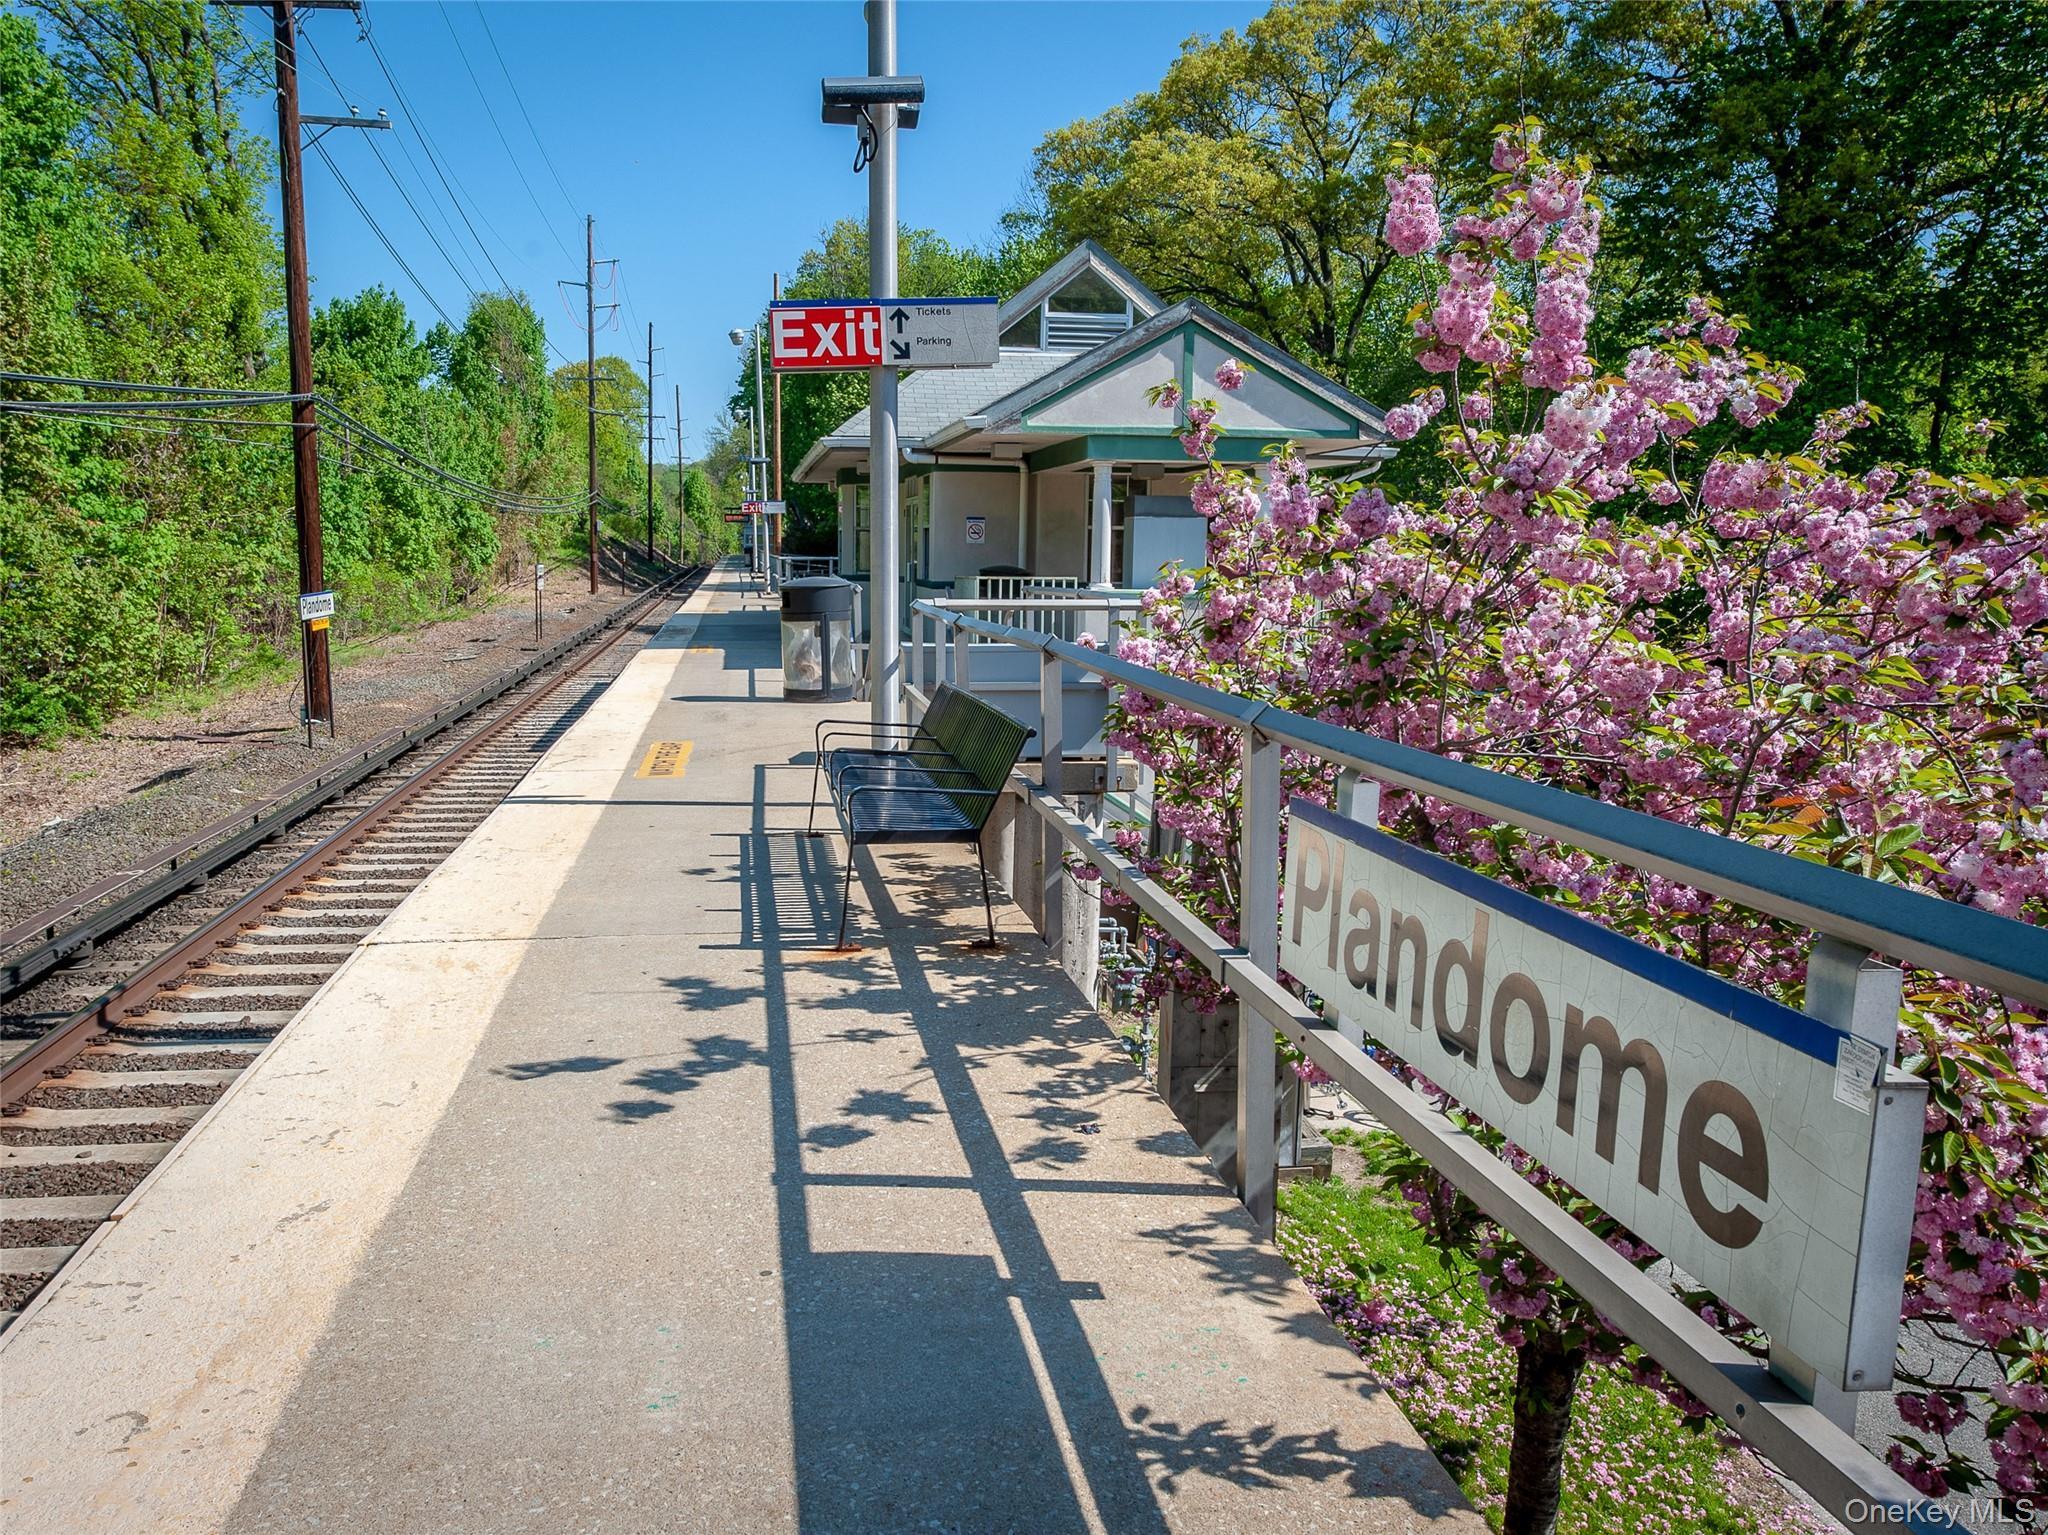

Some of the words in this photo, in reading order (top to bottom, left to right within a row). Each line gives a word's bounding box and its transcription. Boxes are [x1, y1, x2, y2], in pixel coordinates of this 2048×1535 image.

[916, 307, 951, 316] Tickets
[772, 309, 880, 358] Exit
[916, 336, 952, 347] Parking
[742, 502, 763, 513] Exit
[302, 597, 331, 615] Plandome
[1291, 824, 1769, 1250] Plandome
